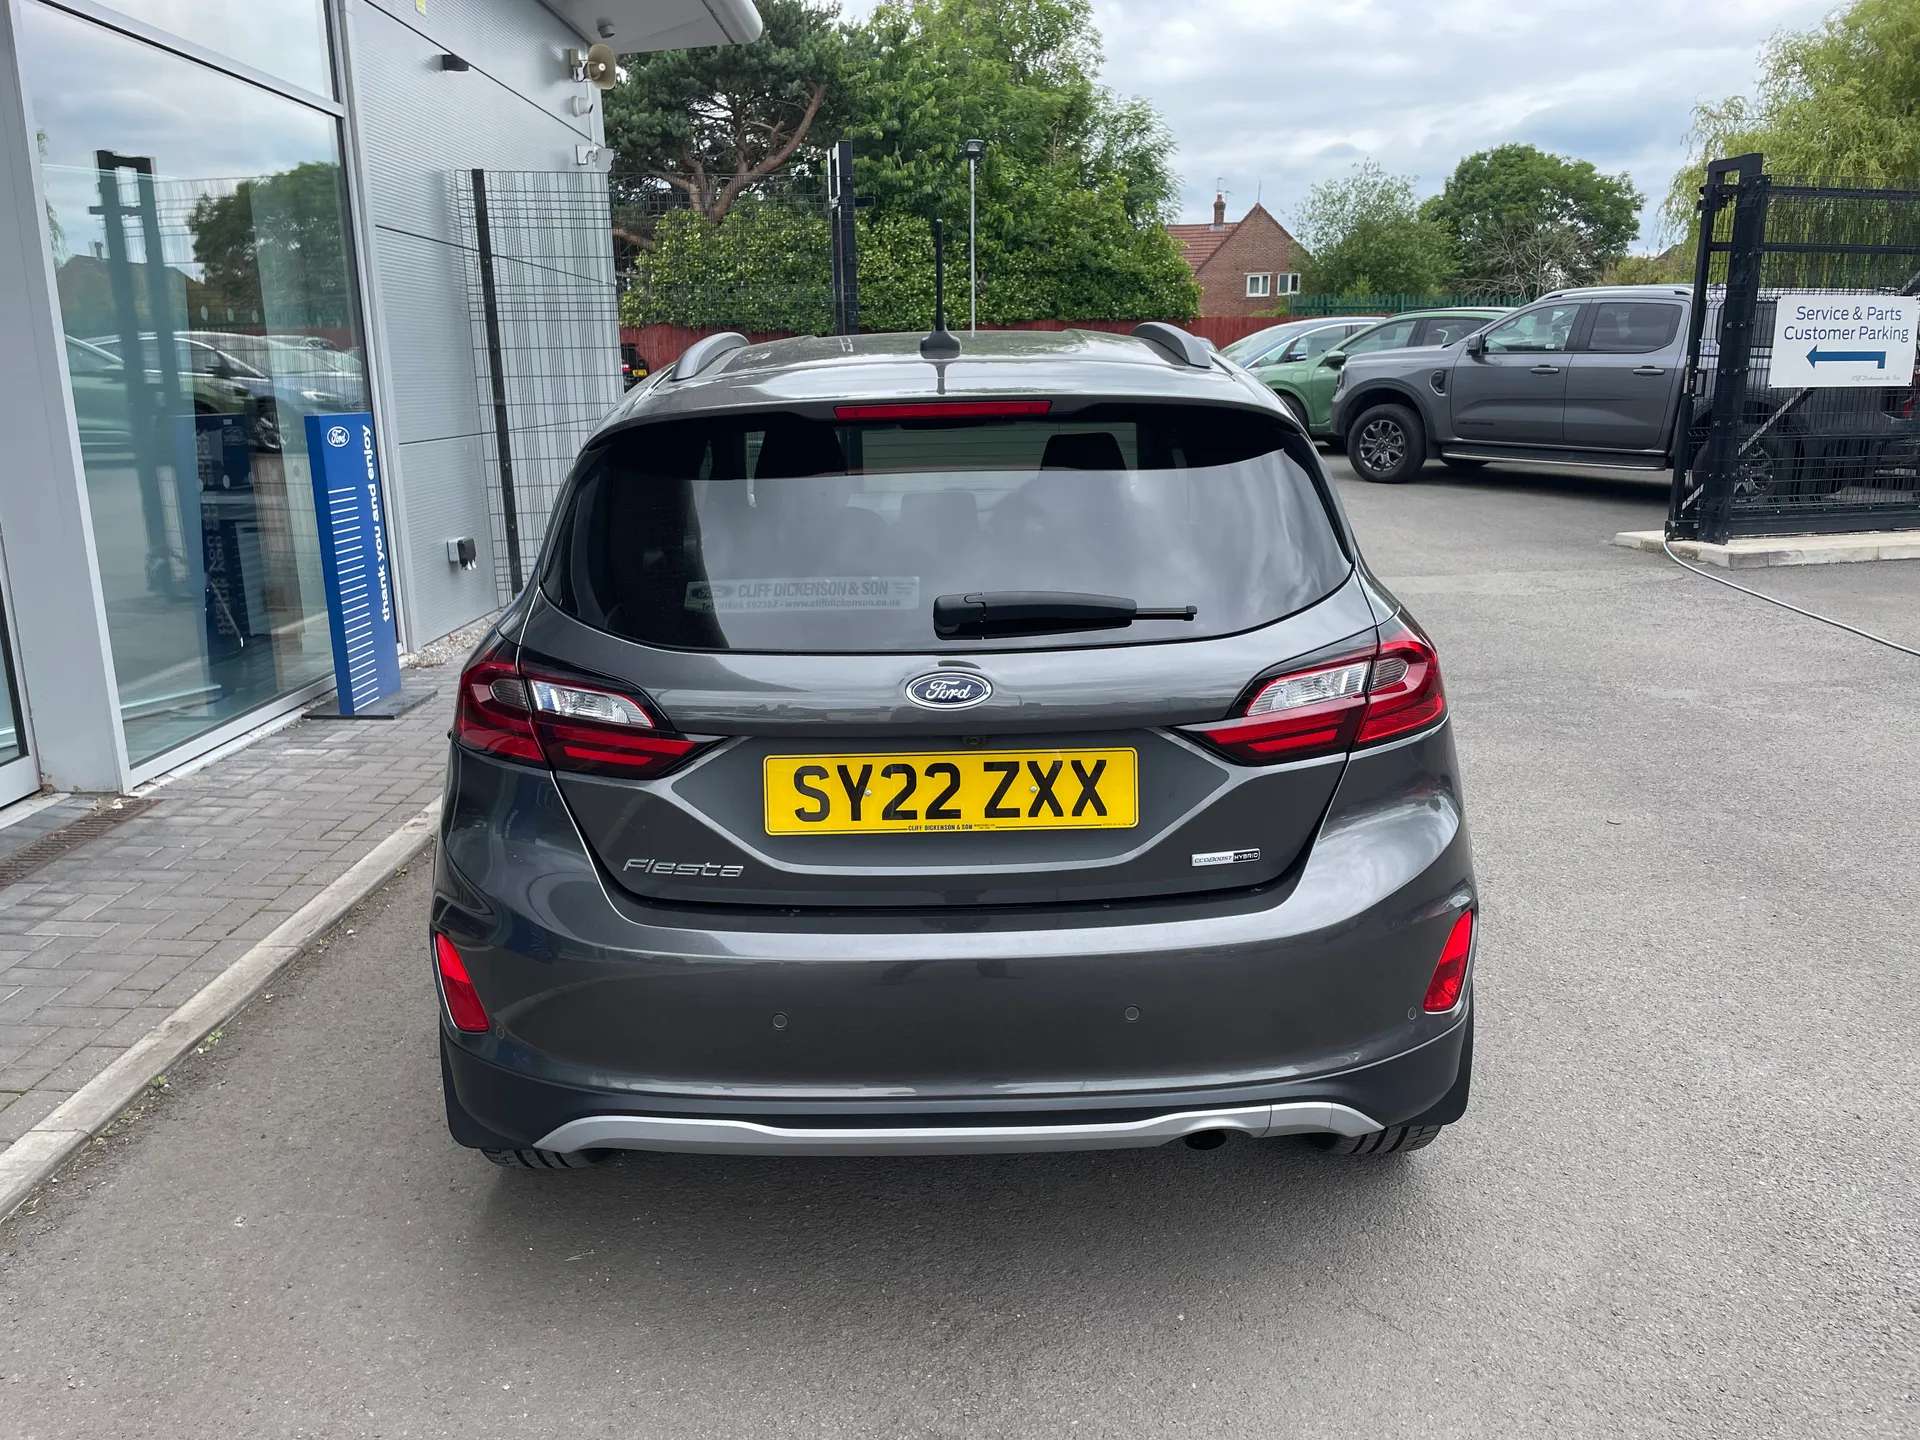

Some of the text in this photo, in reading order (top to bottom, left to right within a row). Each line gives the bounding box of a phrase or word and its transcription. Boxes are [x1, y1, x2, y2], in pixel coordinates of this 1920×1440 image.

[1796, 306, 1902, 321] Service & Parts
[1784, 326, 1909, 343] Customer Parking
[329, 428, 347, 445] Ford
[362, 424, 391, 622] thank you and enjoy
[738, 583, 773, 598] CLIFF
[773, 581, 848, 597] DICKENSON
[861, 581, 889, 596] SON
[925, 679, 972, 700] Ford
[793, 759, 1108, 823] SY22 ZXX
[1234, 852, 1259, 860] HYBRID
[622, 858, 744, 877] Fiesta
